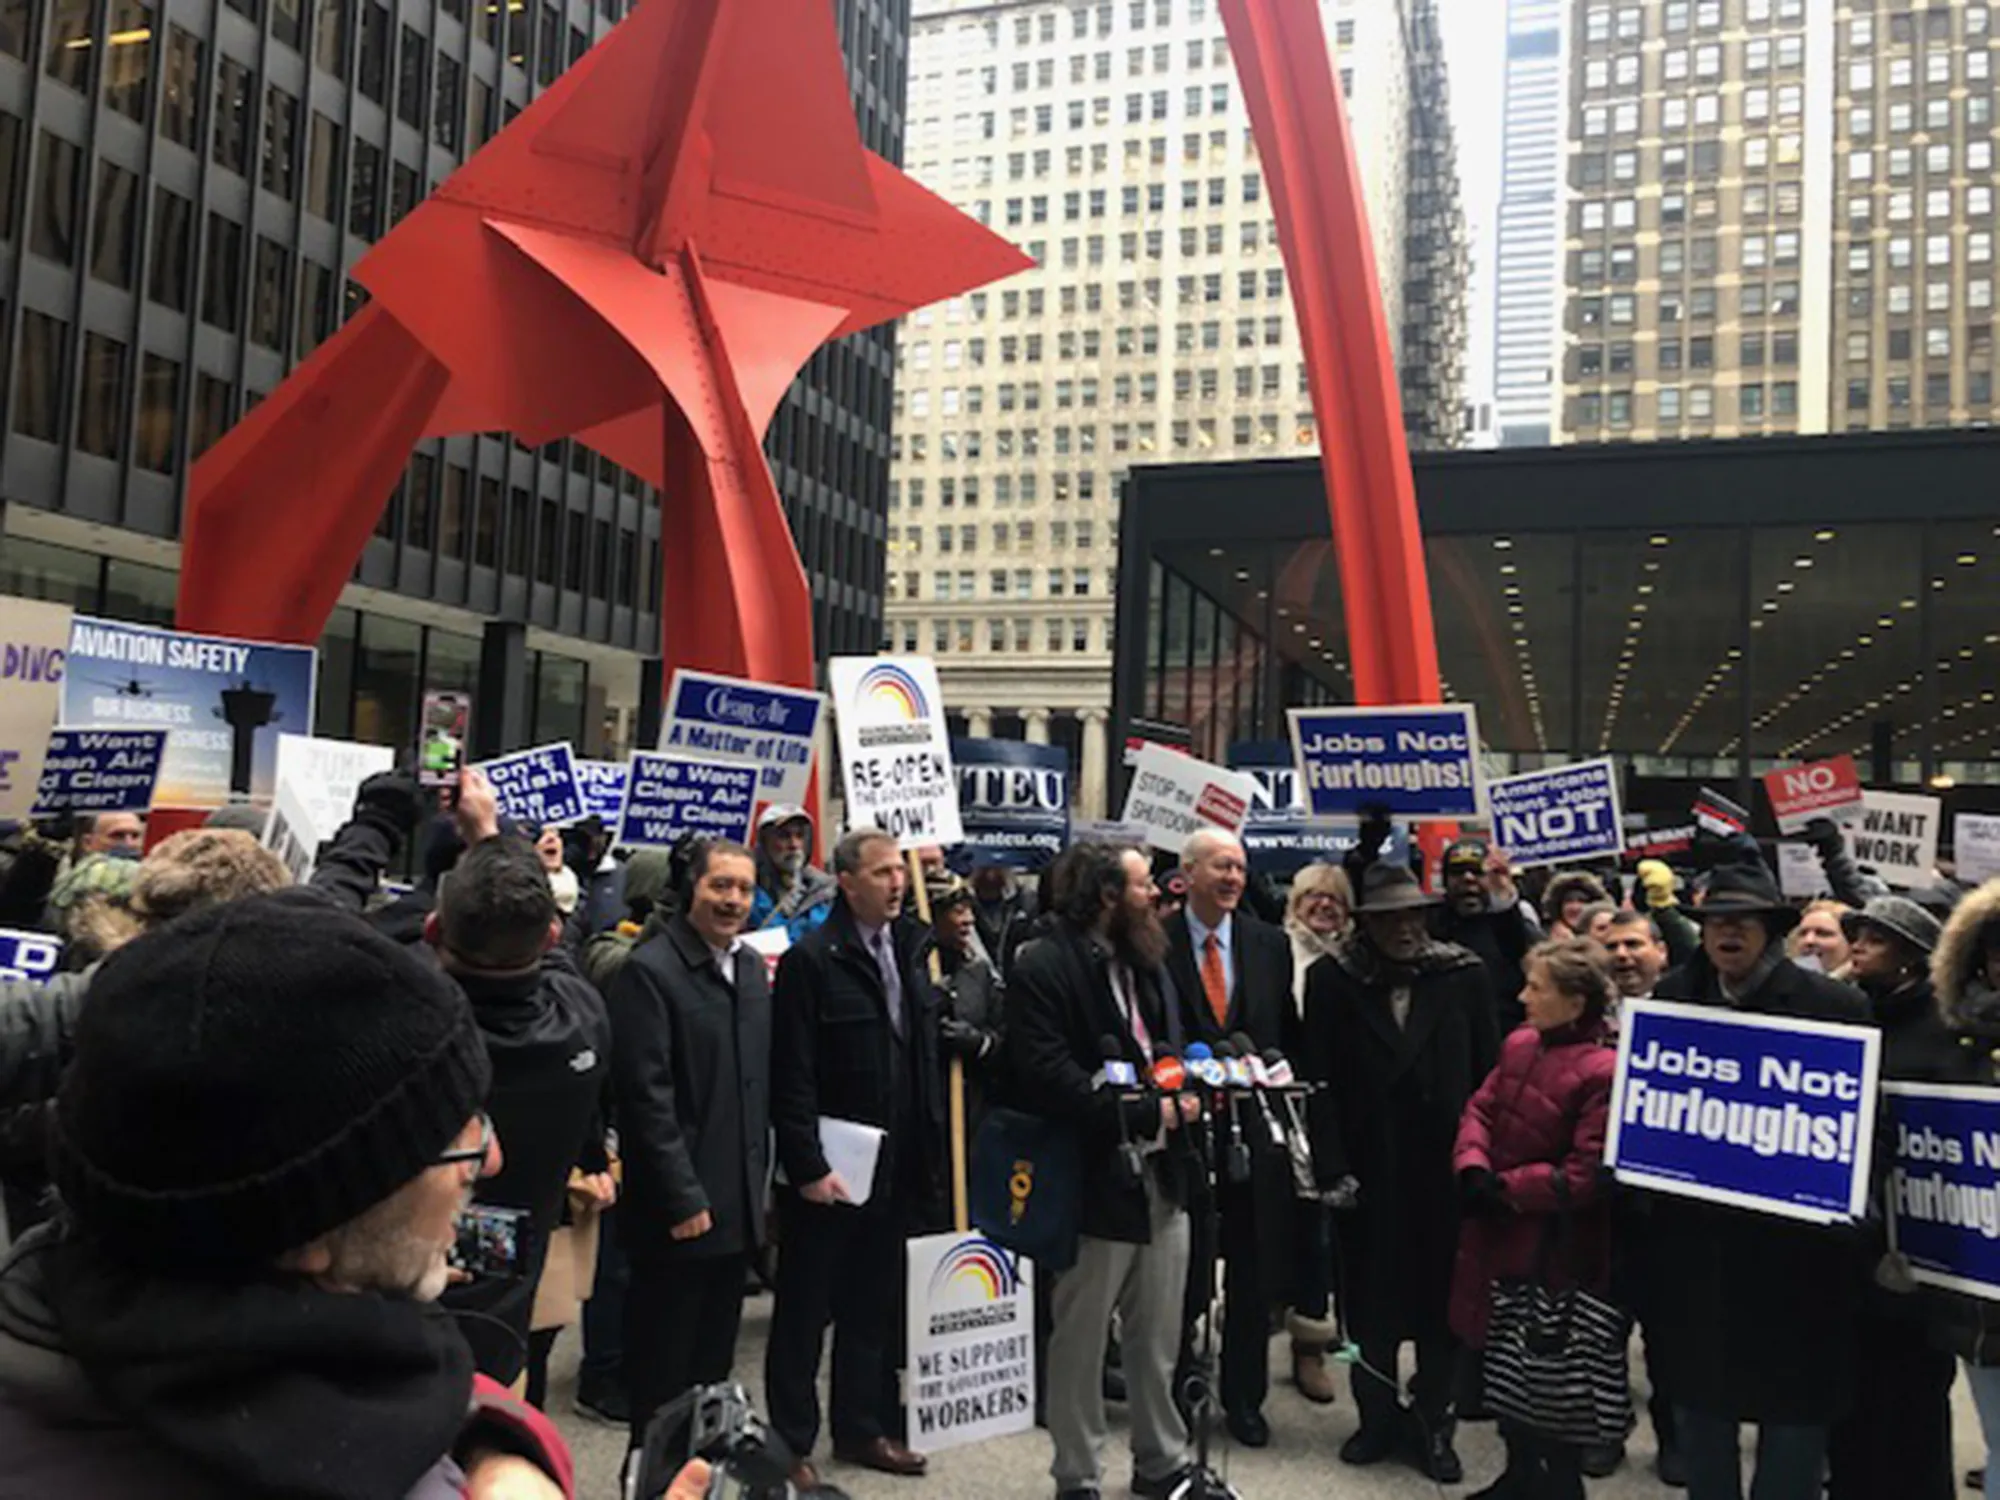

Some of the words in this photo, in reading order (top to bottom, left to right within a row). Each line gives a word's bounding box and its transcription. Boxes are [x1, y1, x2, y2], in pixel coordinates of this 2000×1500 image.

[70, 623, 165, 666] AVIATION
[167, 639, 250, 674] SAFETY
[78, 733, 158, 748] Want
[669, 724, 683, 745] A
[686, 727, 751, 755] Matter
[756, 739, 774, 760] of
[776, 740, 809, 765] Life
[1303, 734, 1386, 754] Jobs
[1396, 731, 1467, 752] Not
[107, 752, 156, 769] Air
[490, 753, 557, 783] on't
[640, 759, 680, 781] We
[686, 765, 751, 787] Want
[851, 752, 946, 789] RE-OPEN
[1306, 758, 1472, 792] Furloughs!
[69, 773, 153, 789] Clean
[501, 769, 569, 797] nish
[634, 780, 703, 803] Clean
[709, 787, 749, 806] Air
[953, 766, 1066, 812] TEU
[1137, 771, 1176, 798] STOP
[1493, 768, 1607, 800] Americans
[1783, 765, 1837, 795] NO
[627, 802, 676, 820] and
[681, 804, 746, 826] Clean
[1494, 797, 1550, 816] Want
[1555, 784, 1611, 805] Jobs
[874, 801, 937, 839] NOW!
[1502, 801, 1606, 845] NOT
[1863, 809, 1928, 839] WANT
[1854, 835, 1921, 868] WORK
[1629, 1040, 1741, 1083] Jobs
[1758, 1055, 1860, 1101] Not
[1623, 1077, 1857, 1165] Furloughs!
[1897, 1122, 1964, 1165] Jobs
[1893, 1166, 2000, 1239] Furloug
[917, 1351, 943, 1378] WE
[948, 1333, 1028, 1373] SUPPORT
[916, 1381, 1030, 1436] WORKERS
